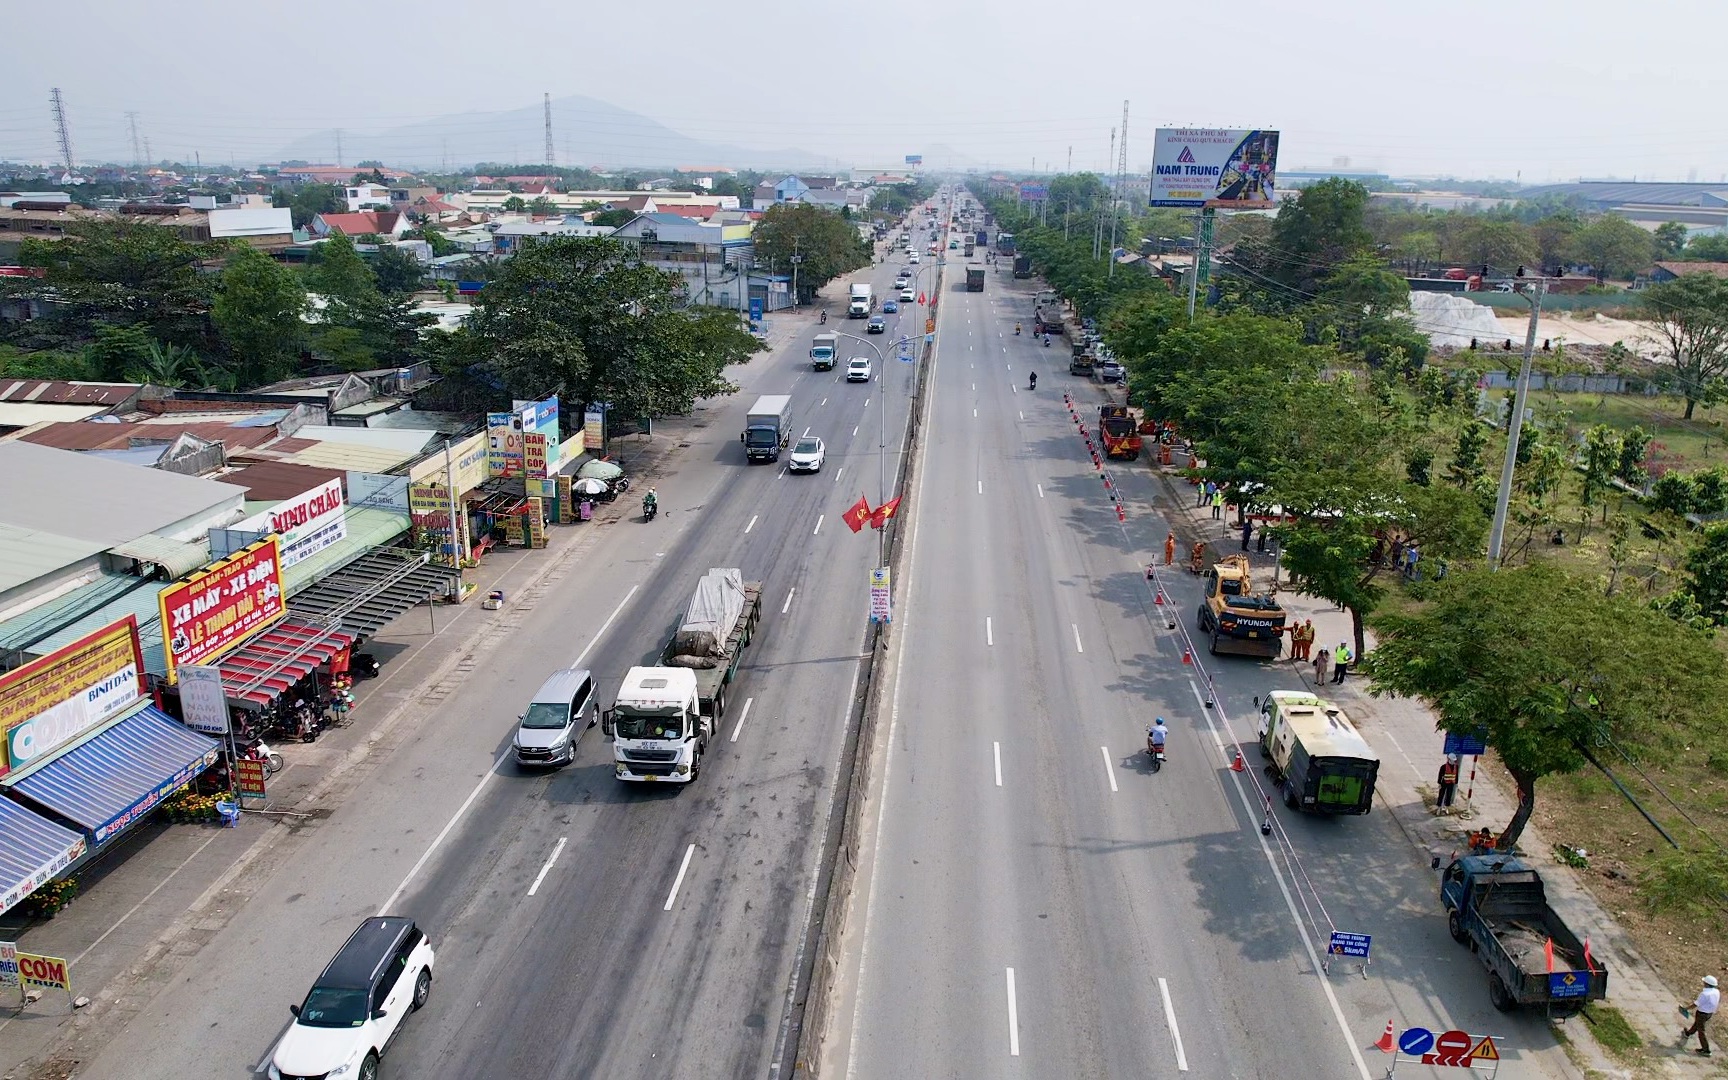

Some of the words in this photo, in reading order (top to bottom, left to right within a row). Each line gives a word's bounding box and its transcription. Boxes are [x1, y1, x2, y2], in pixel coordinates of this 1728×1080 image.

[1156, 165, 1182, 175] NAM
[1184, 165, 1220, 176] TRUNG
[272, 502, 308, 533] MINH
[309, 487, 341, 519] CHÂU
[171, 602, 192, 628] XE
[192, 587, 222, 618] MÁY
[228, 572, 247, 596] XE
[247, 557, 275, 583] ĐIỆN
[189, 620, 204, 645] LÊ
[1236, 617, 1273, 627] HYUNDAI
[1344, 946, 1365, 955] 5km/h
[19, 957, 66, 983] CƠM
